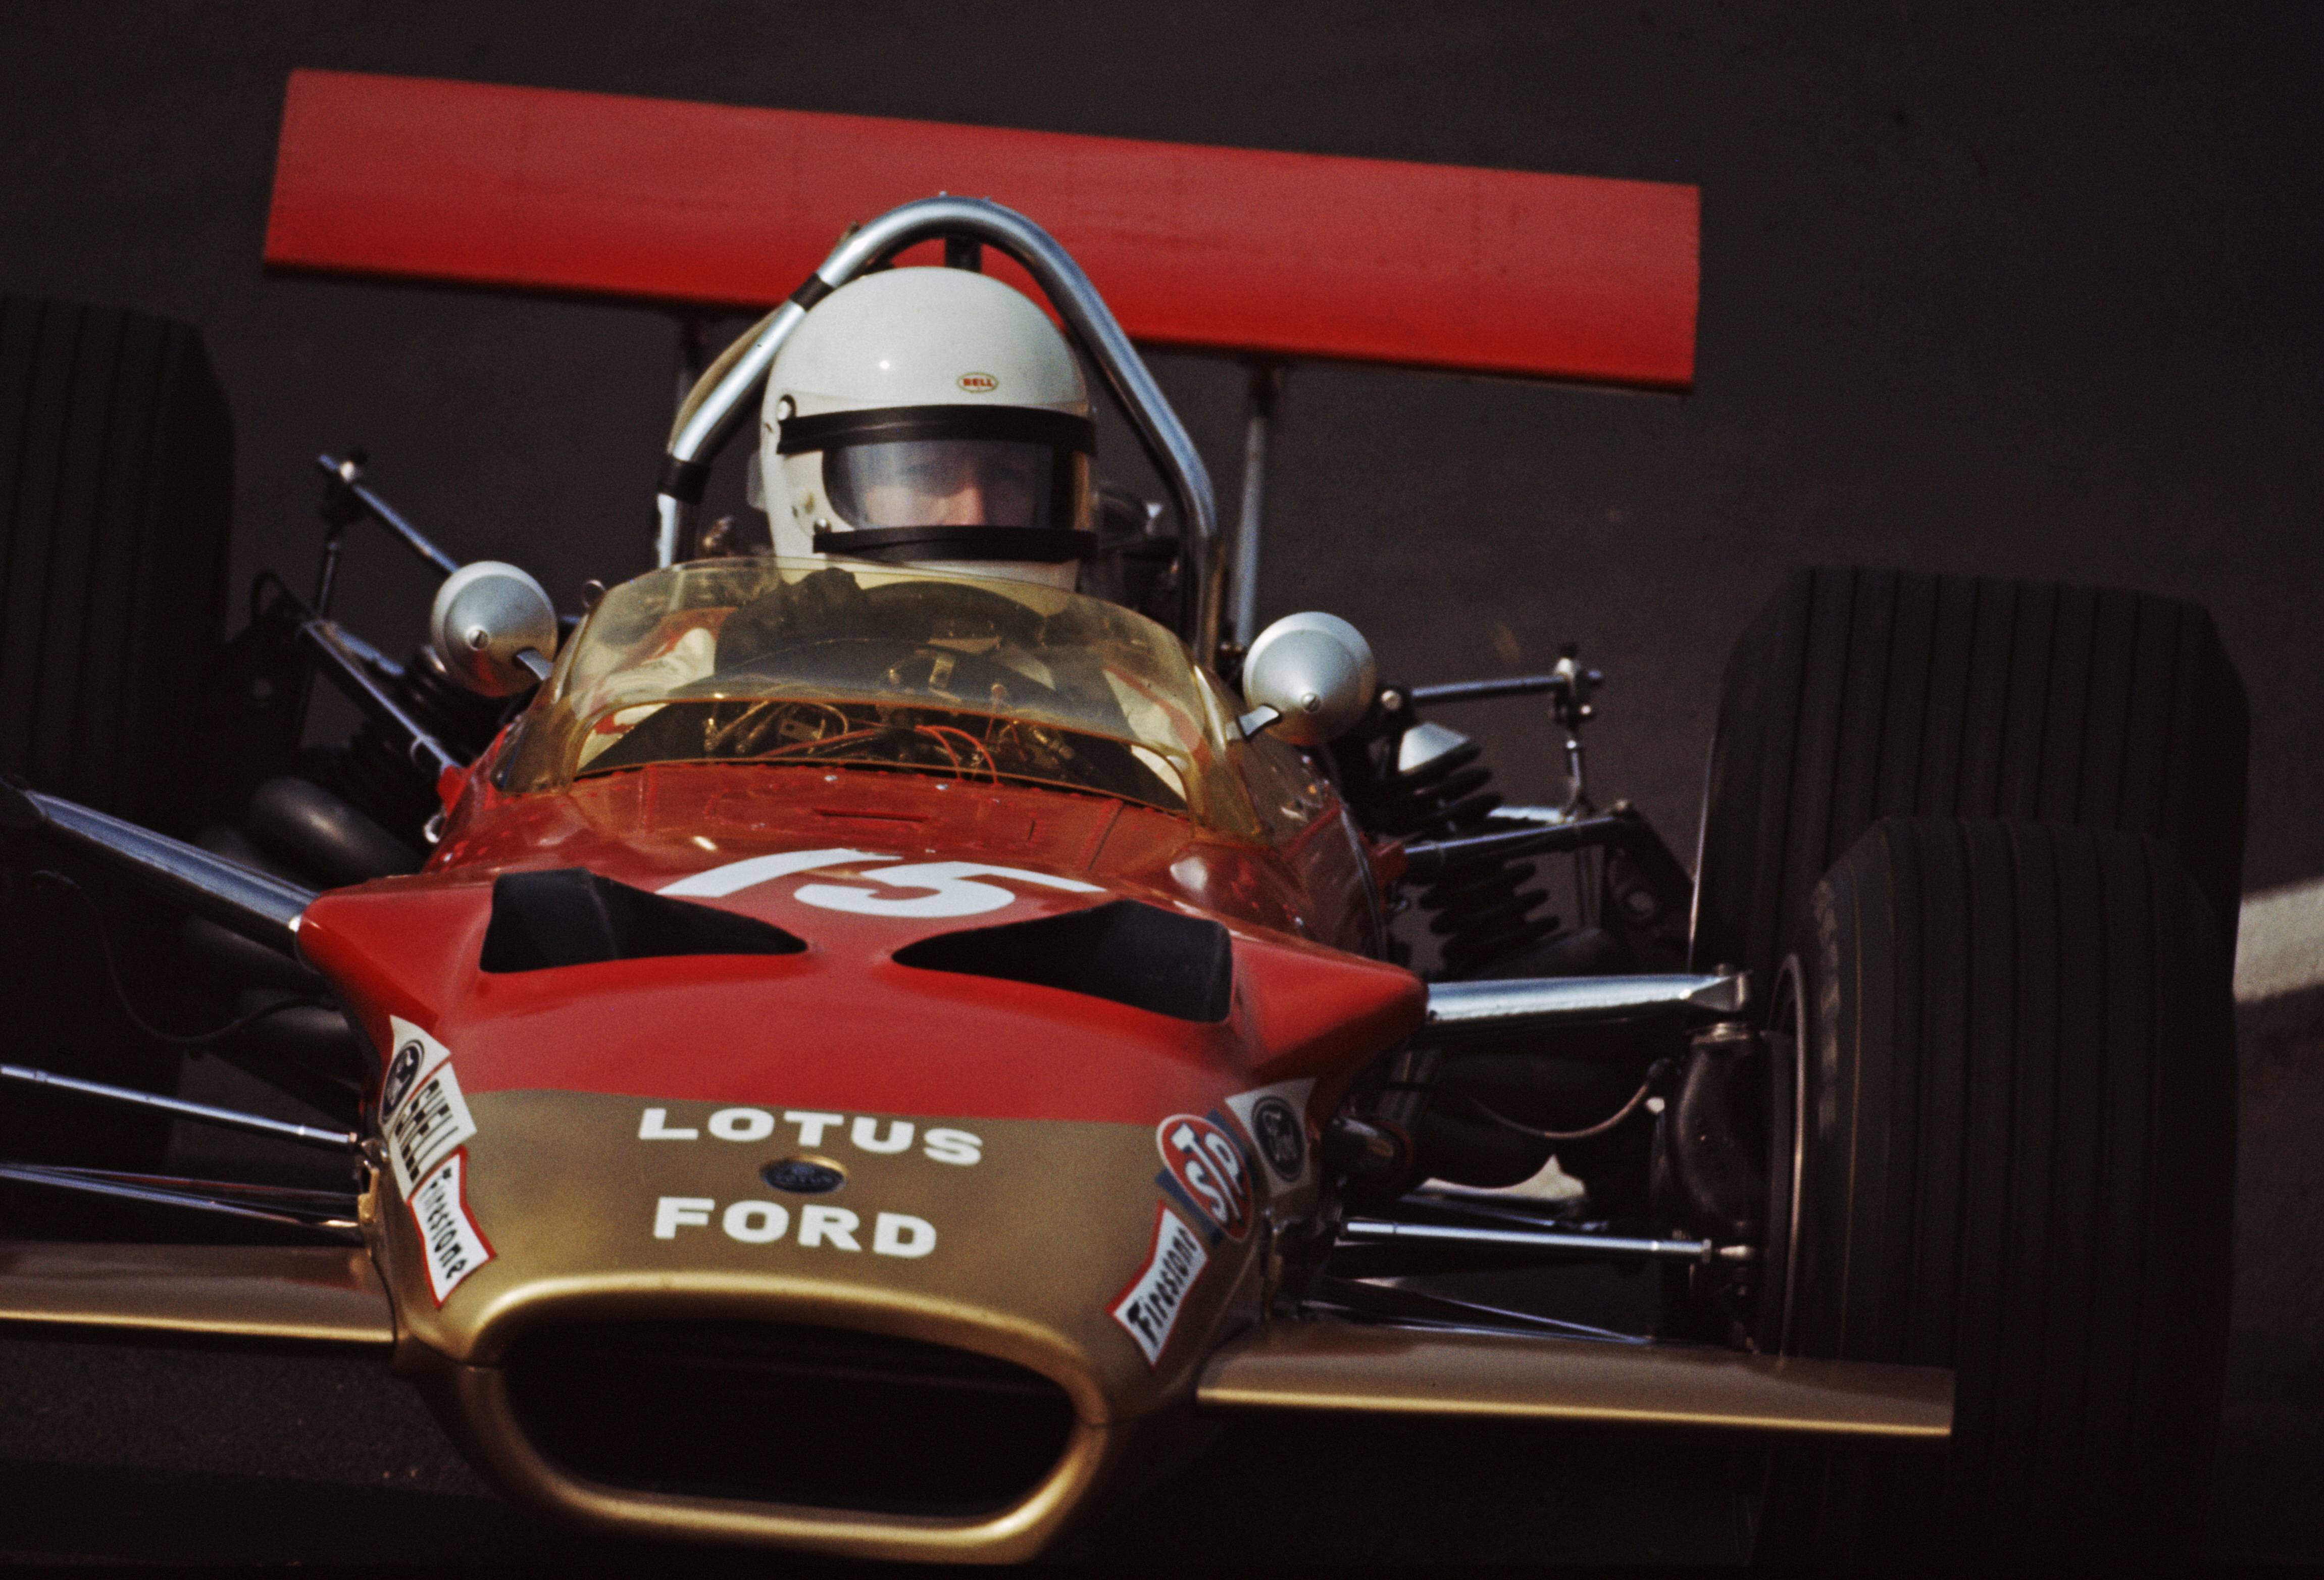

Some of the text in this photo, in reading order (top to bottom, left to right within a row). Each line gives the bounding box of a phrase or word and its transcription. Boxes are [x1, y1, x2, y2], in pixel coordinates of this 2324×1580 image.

[963, 378, 994, 387] BELL
[655, 847, 1107, 918] 15
[638, 1107, 983, 1166] LOTUS
[1170, 1120, 1246, 1225] STP
[418, 1166, 468, 1280] Firestone
[653, 1196, 937, 1258] FORD
[1127, 1227, 1197, 1347] Firestone
